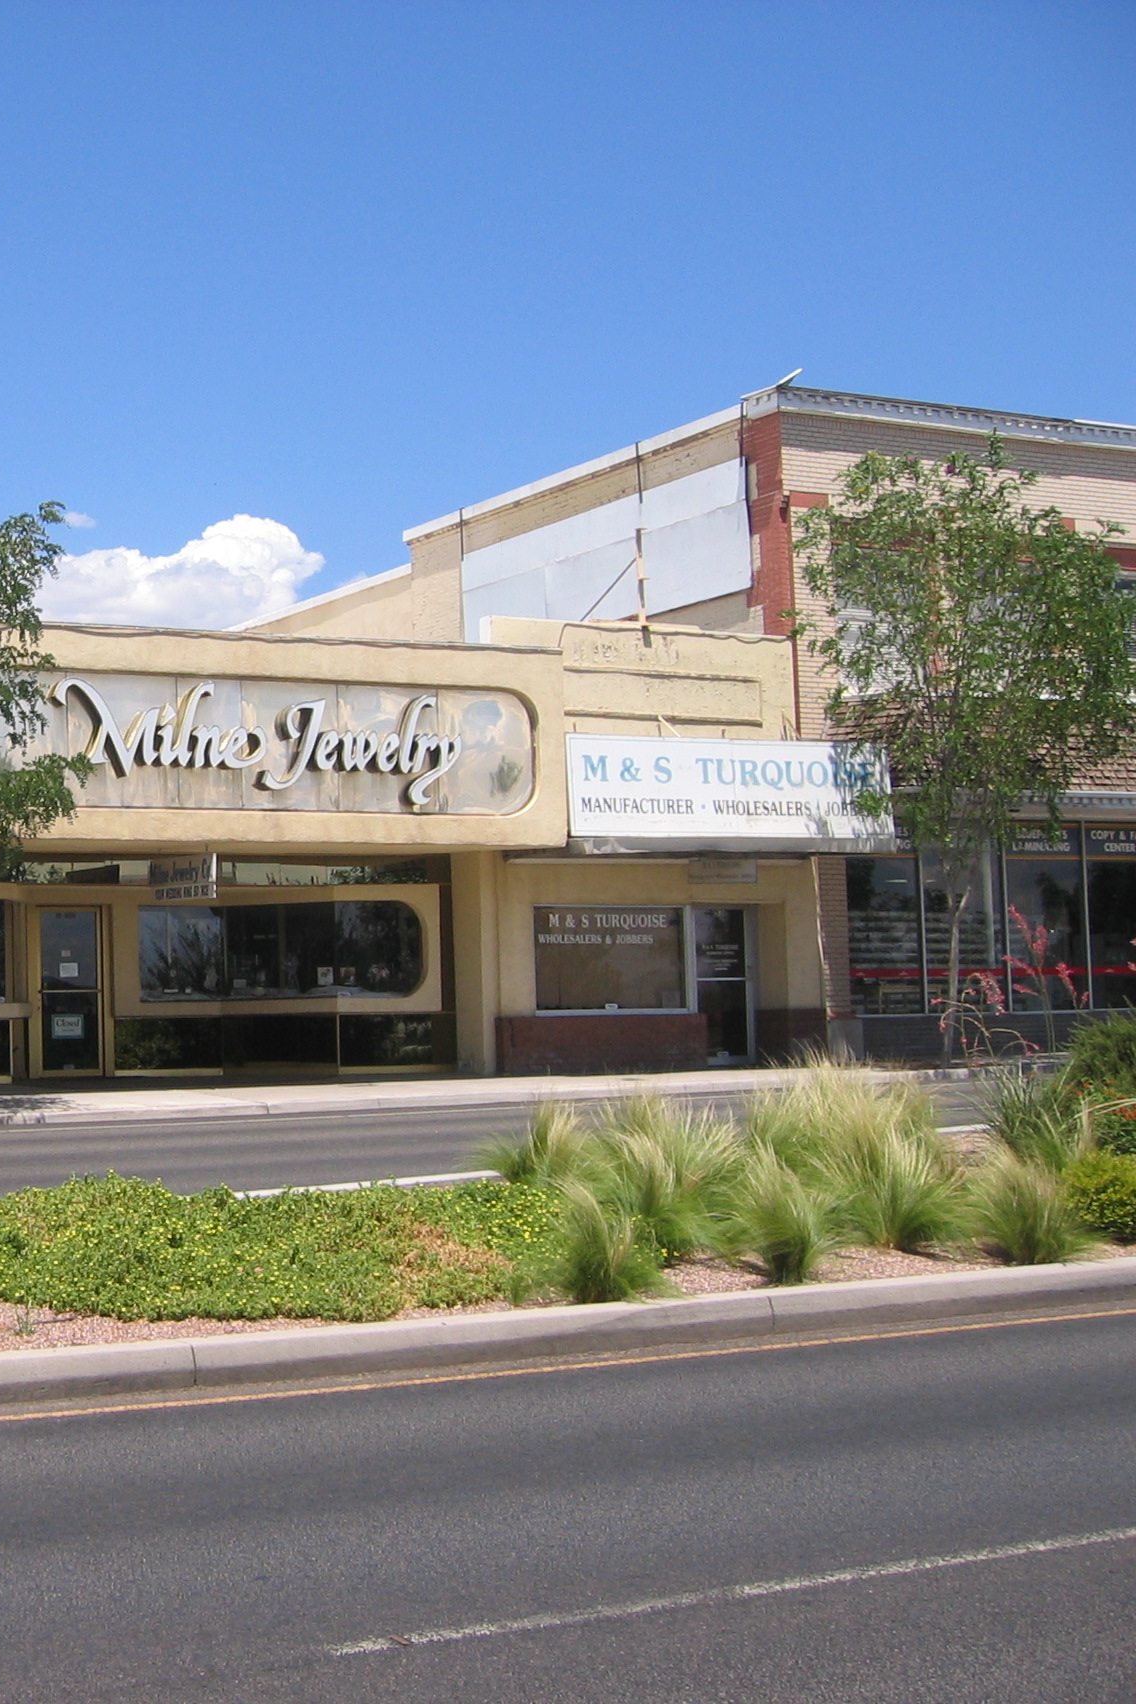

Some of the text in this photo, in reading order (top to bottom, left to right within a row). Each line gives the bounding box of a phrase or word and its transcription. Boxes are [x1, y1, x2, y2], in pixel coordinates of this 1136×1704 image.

[46, 676, 462, 806] Milne Jewelry
[581, 755, 879, 790] M & S TURQUOISE
[581, 797, 694, 815] MANUFACTURER
[713, 799, 812, 817] WHOLESALERS
[1090, 830, 1115, 839] COPY
[1104, 842, 1135, 852] CENTER
[549, 914, 667, 929] M & S TURQUOISE
[538, 934, 602, 944] WHOLESALERS
[615, 934, 654, 944] JOBBERS
